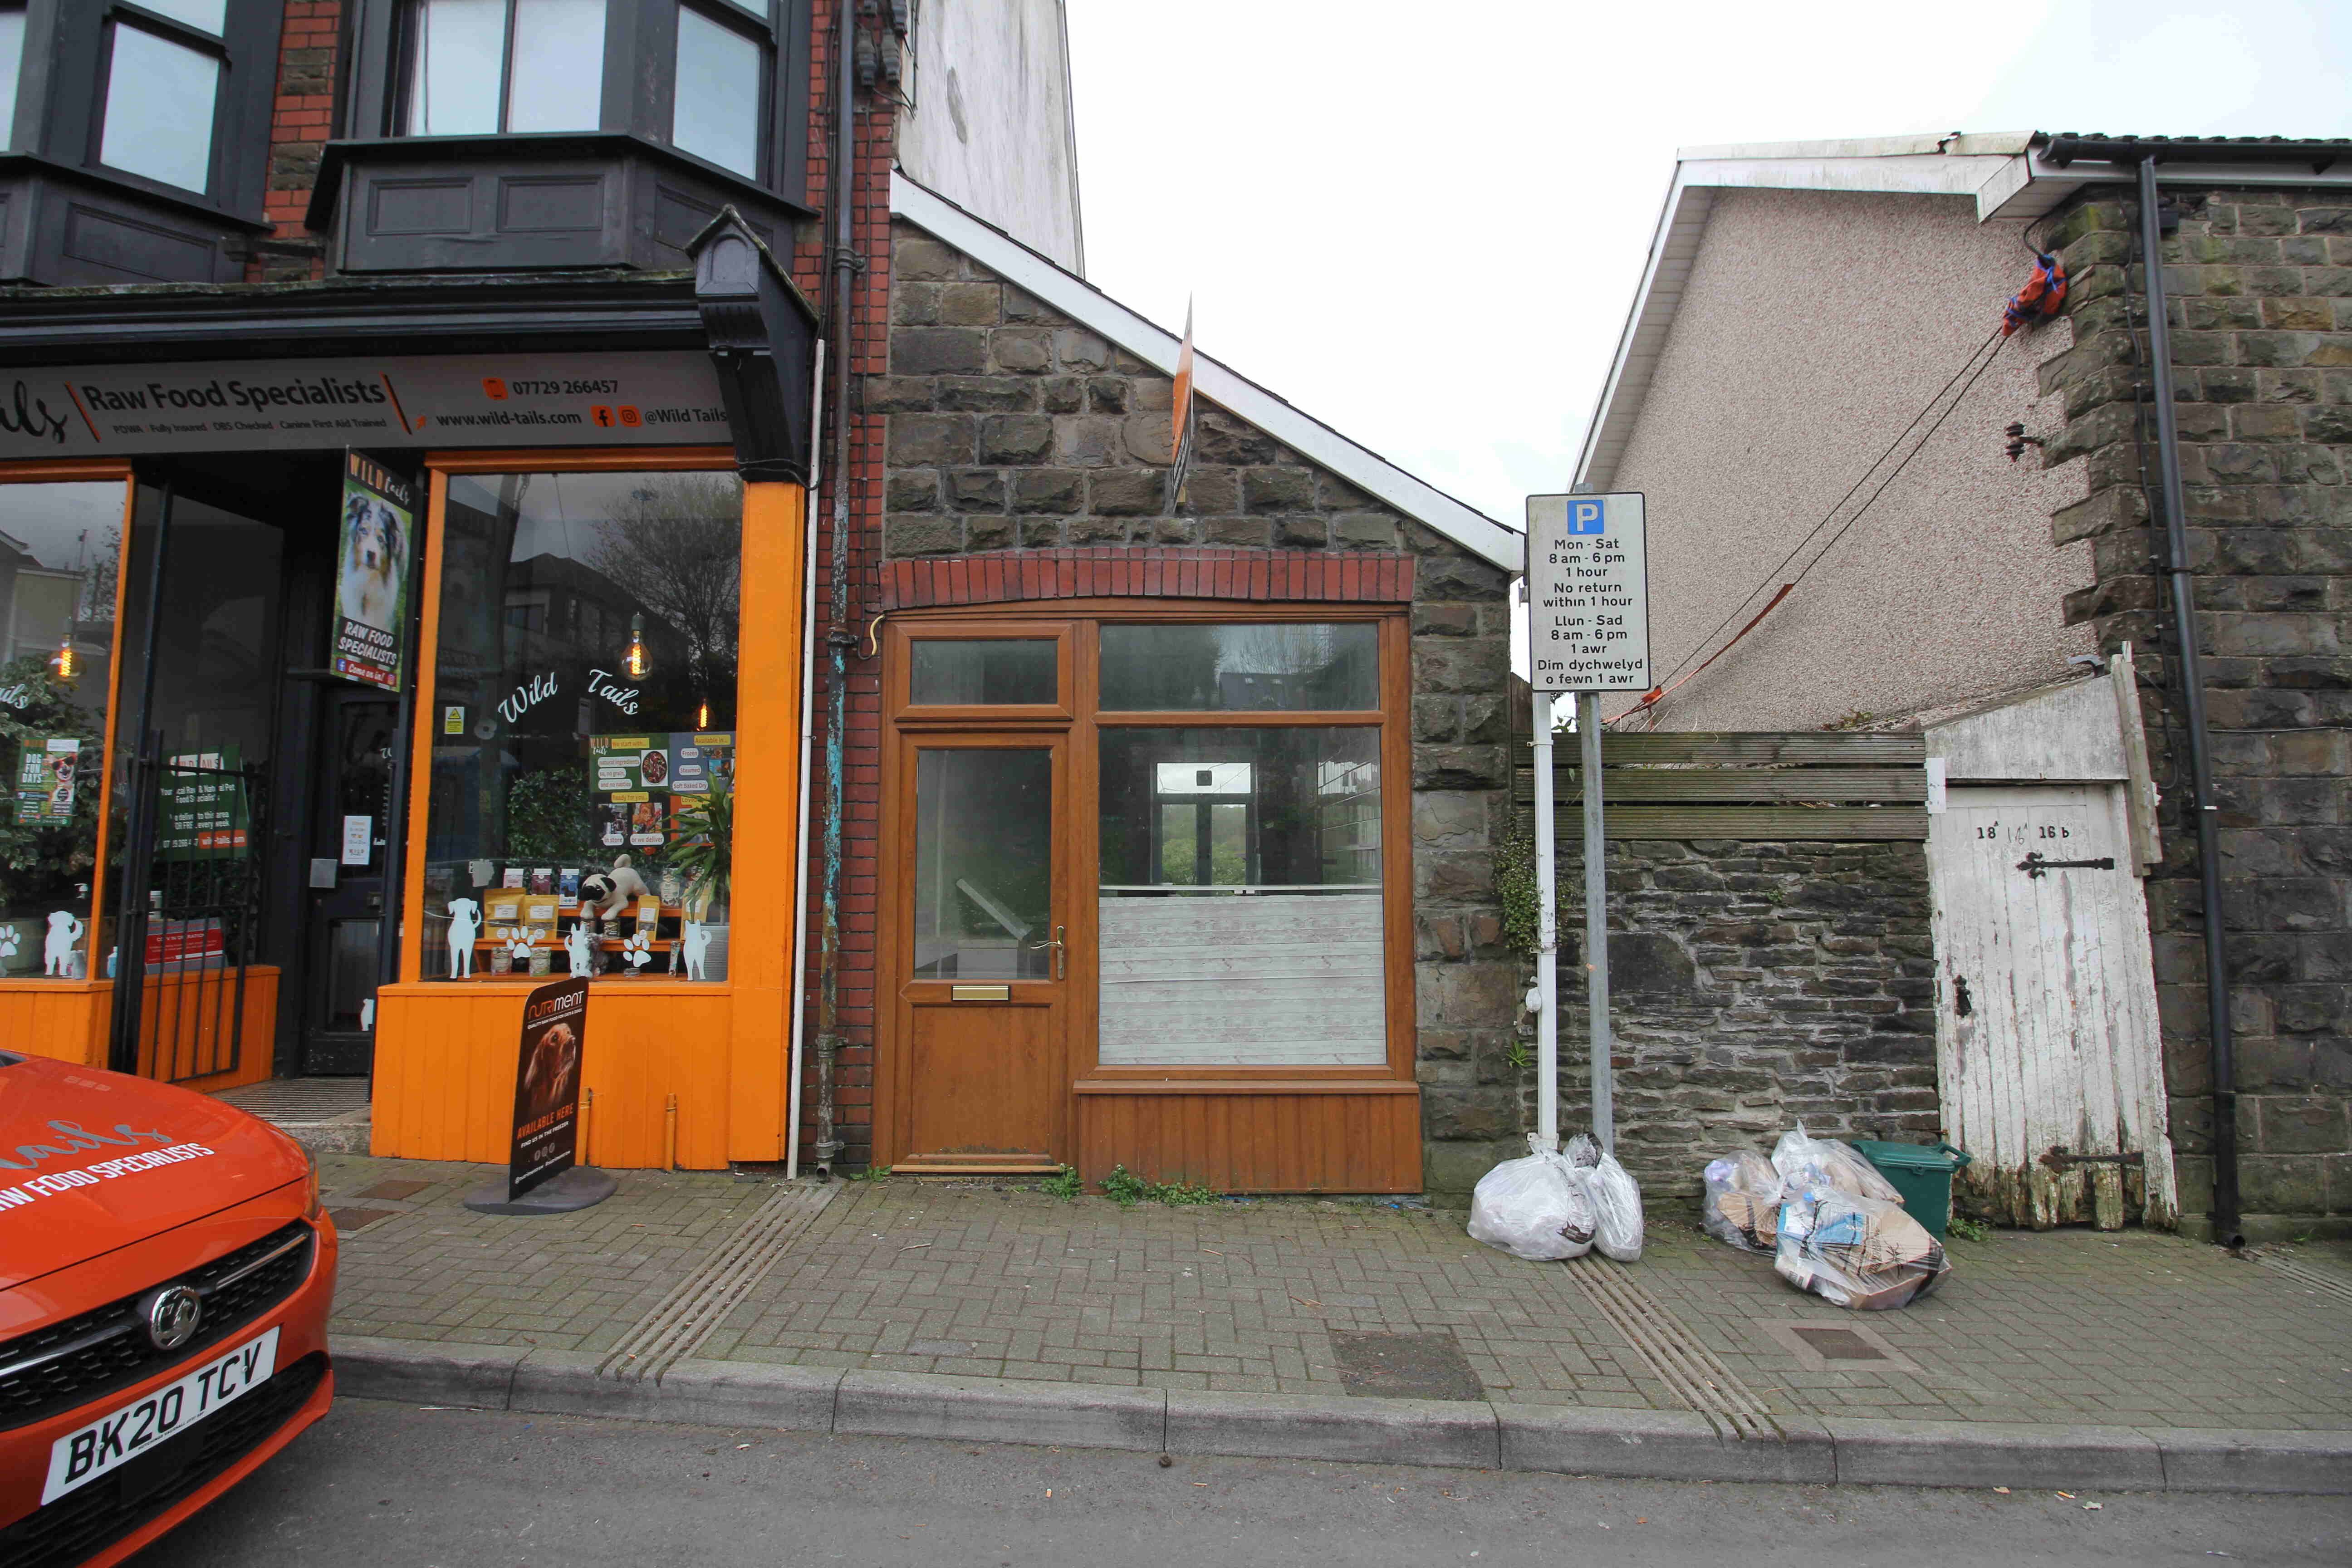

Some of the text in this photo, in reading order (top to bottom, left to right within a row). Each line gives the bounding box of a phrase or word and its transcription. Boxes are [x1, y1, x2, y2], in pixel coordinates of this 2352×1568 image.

[513, 379, 619, 395] 07729 266457
[82, 378, 386, 412] Raw Food Specialists
[436, 410, 582, 426] www.wild-tails.com
[644, 407, 727, 424] @Wild Tails
[235, 420, 274, 430] Checked
[279, 420, 312, 429] Canine
[312, 419, 333, 428] First
[335, 418, 351, 428] Aid
[352, 417, 387, 428] Trained
[349, 453, 385, 490] WILD
[1576, 504, 1598, 532] P
[1554, 539, 1583, 550] Mon
[1596, 539, 1619, 549] Sat
[1549, 554, 1557, 564] 8
[1561, 555, 1581, 564] am
[1592, 553, 1601, 563] 6
[1605, 555, 1625, 565] pm
[1566, 567, 1607, 578] 1 hour
[1554, 583, 1622, 593] No return
[1543, 597, 1632, 608] within 1 hour
[1555, 616, 1584, 626] Llun
[1596, 615, 1622, 626] Sad
[344, 621, 394, 648] RAW FOOD
[1551, 630, 1559, 640] 8
[1595, 629, 1603, 640] 6
[1607, 631, 1627, 642] pm
[338, 636, 397, 666] SPECIALISTS
[1571, 644, 1607, 654] 1 awr
[1538, 658, 1643, 672] Dim dychwelyd
[1546, 673, 1634, 684] o fewn 1 awr
[497, 668, 639, 724] Wild Tails
[25, 753, 42, 764] DOG
[25, 763, 41, 774] FUN
[21, 773, 42, 784] DAYS
[516, 1102, 574, 1140] AVAILABLE HERE
[520, 1139, 532, 1148] FIND
[544, 1128, 552, 1137] THE
[552, 1120, 569, 1132] FREEZER
[22, 1167, 100, 1197] FOOD
[87, 1142, 216, 1179] SPECIALISTS
[64, 1341, 262, 1485] BK20 TCV
